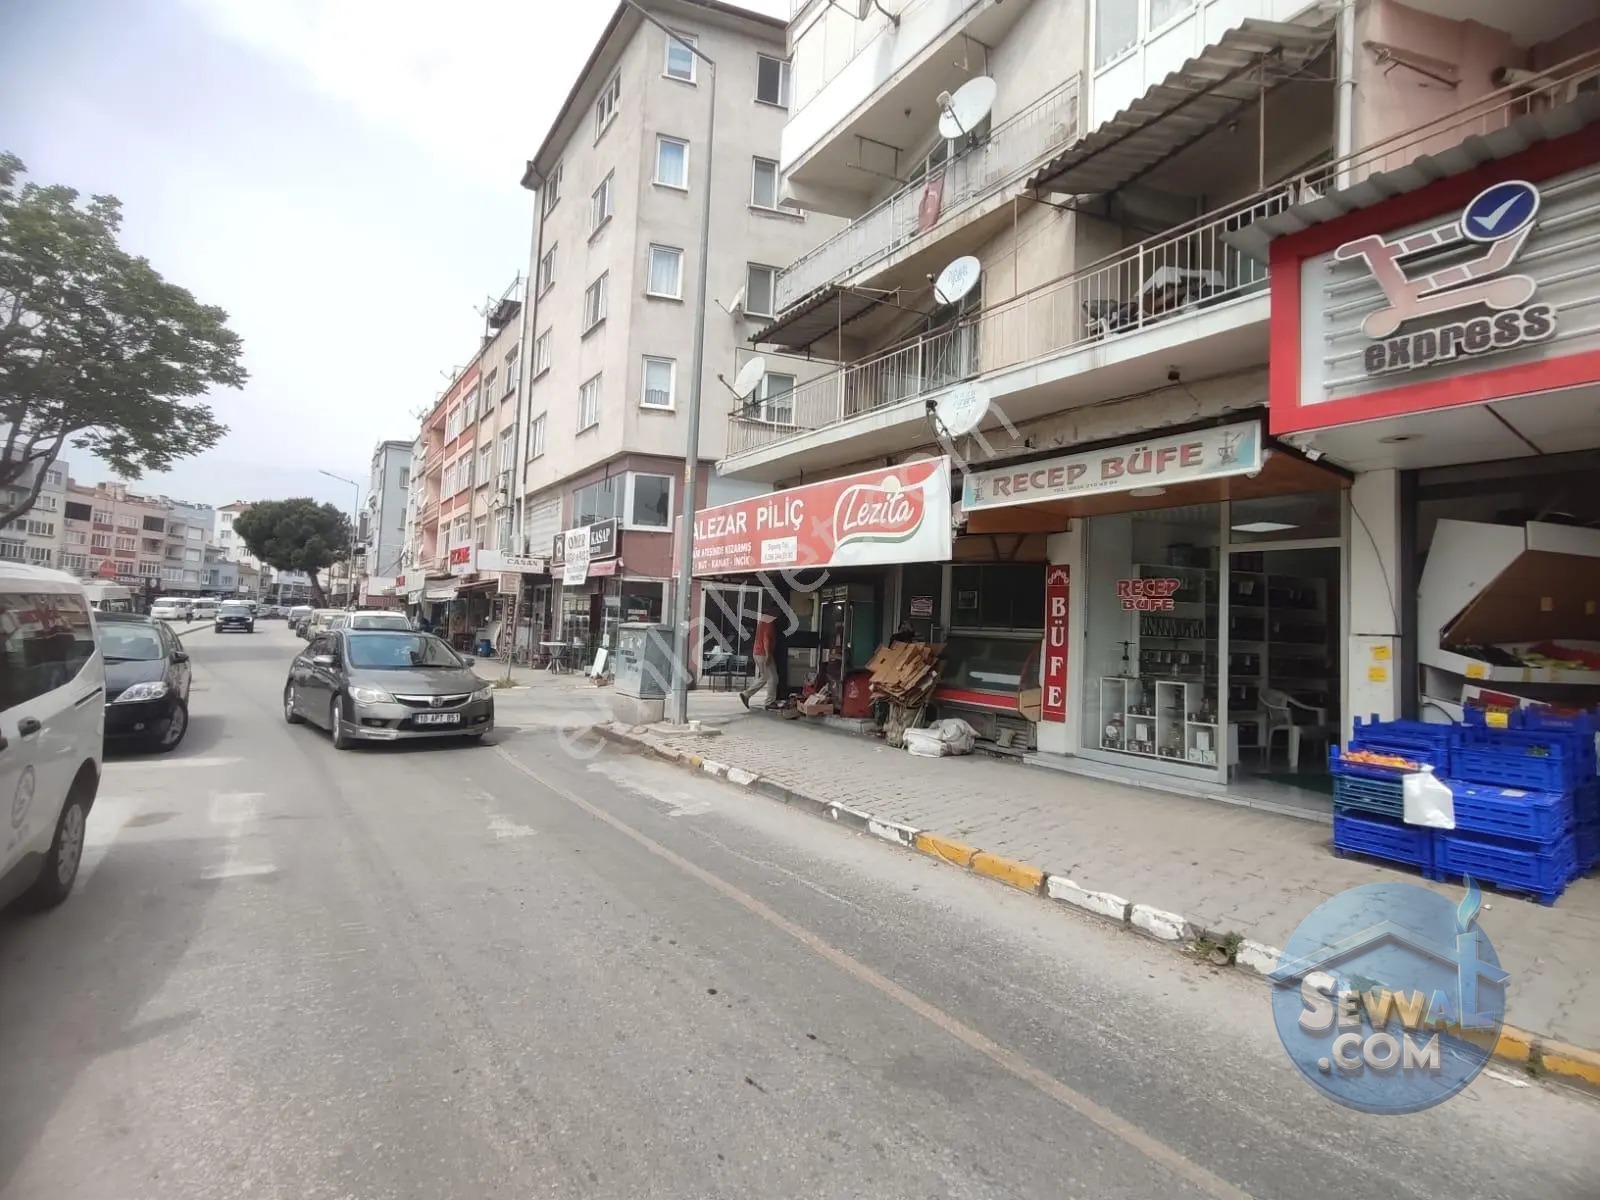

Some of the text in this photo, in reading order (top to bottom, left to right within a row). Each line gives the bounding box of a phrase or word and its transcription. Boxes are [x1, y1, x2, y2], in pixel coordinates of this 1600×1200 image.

[1363, 304, 1553, 371] express
[992, 442, 1203, 497] RECEP BÜFE
[756, 496, 804, 531] PİLİÇ
[843, 487, 915, 531] Lezita
[1116, 578, 1180, 597] RECEP
[1121, 596, 1176, 611] BÜFE
[1047, 597, 1066, 707] BÜFE
